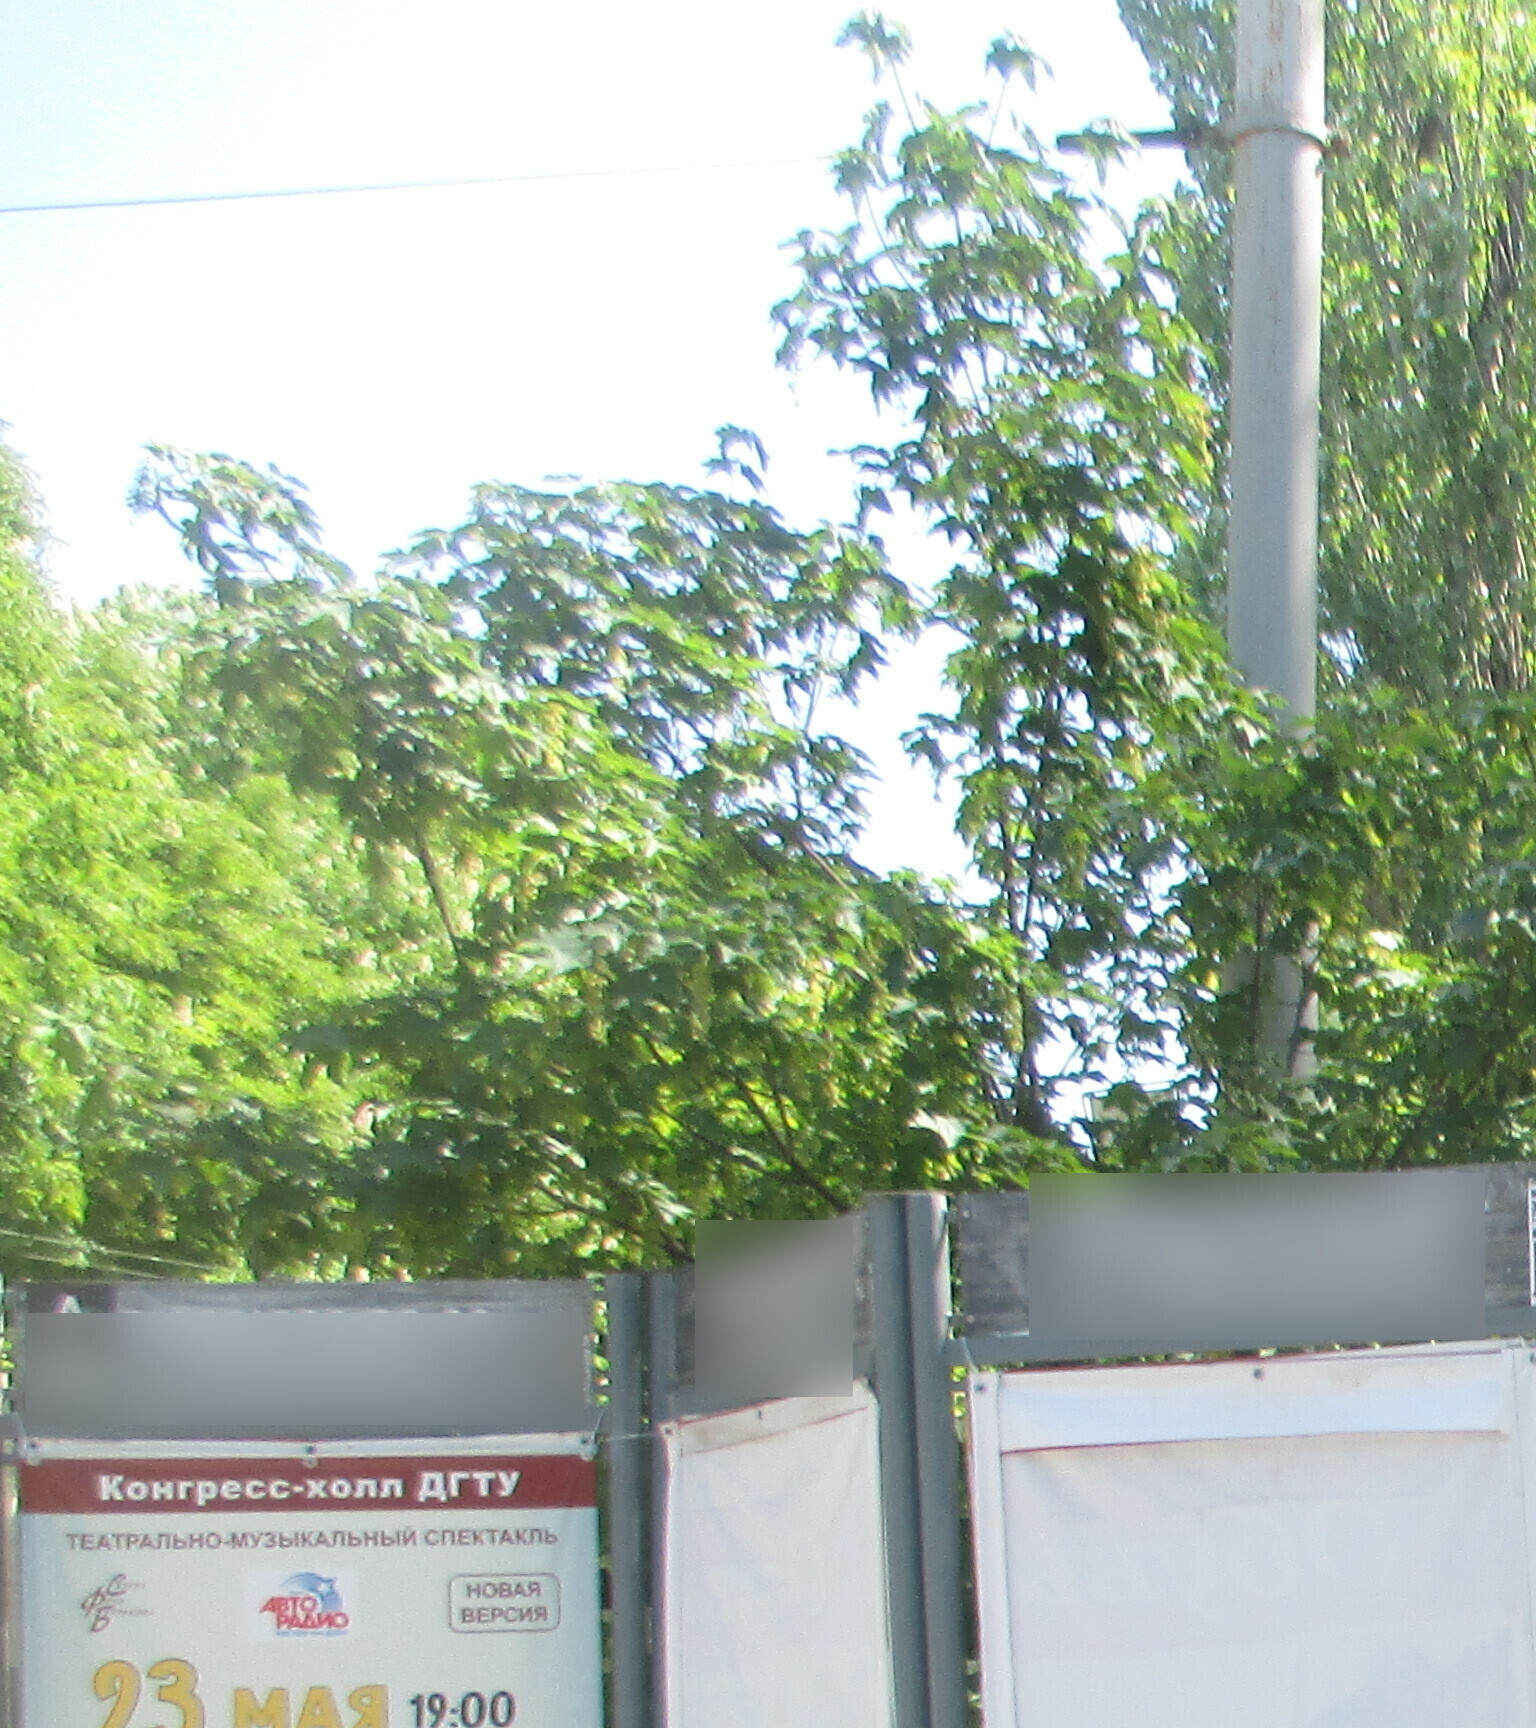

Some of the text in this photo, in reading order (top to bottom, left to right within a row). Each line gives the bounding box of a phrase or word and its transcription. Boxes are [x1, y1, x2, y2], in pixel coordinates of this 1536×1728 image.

[100, 1470, 522, 1507] Конгресс-холл ДГТУ
[65, 1526, 560, 1551] ТЕАТРАЛЬНО-МУЗЫКАЛЬНЫЙ СПЕКТАКЛЬ
[465, 1581, 542, 1599] НОВАЯ
[460, 1606, 549, 1625] ВЕРСИЯ
